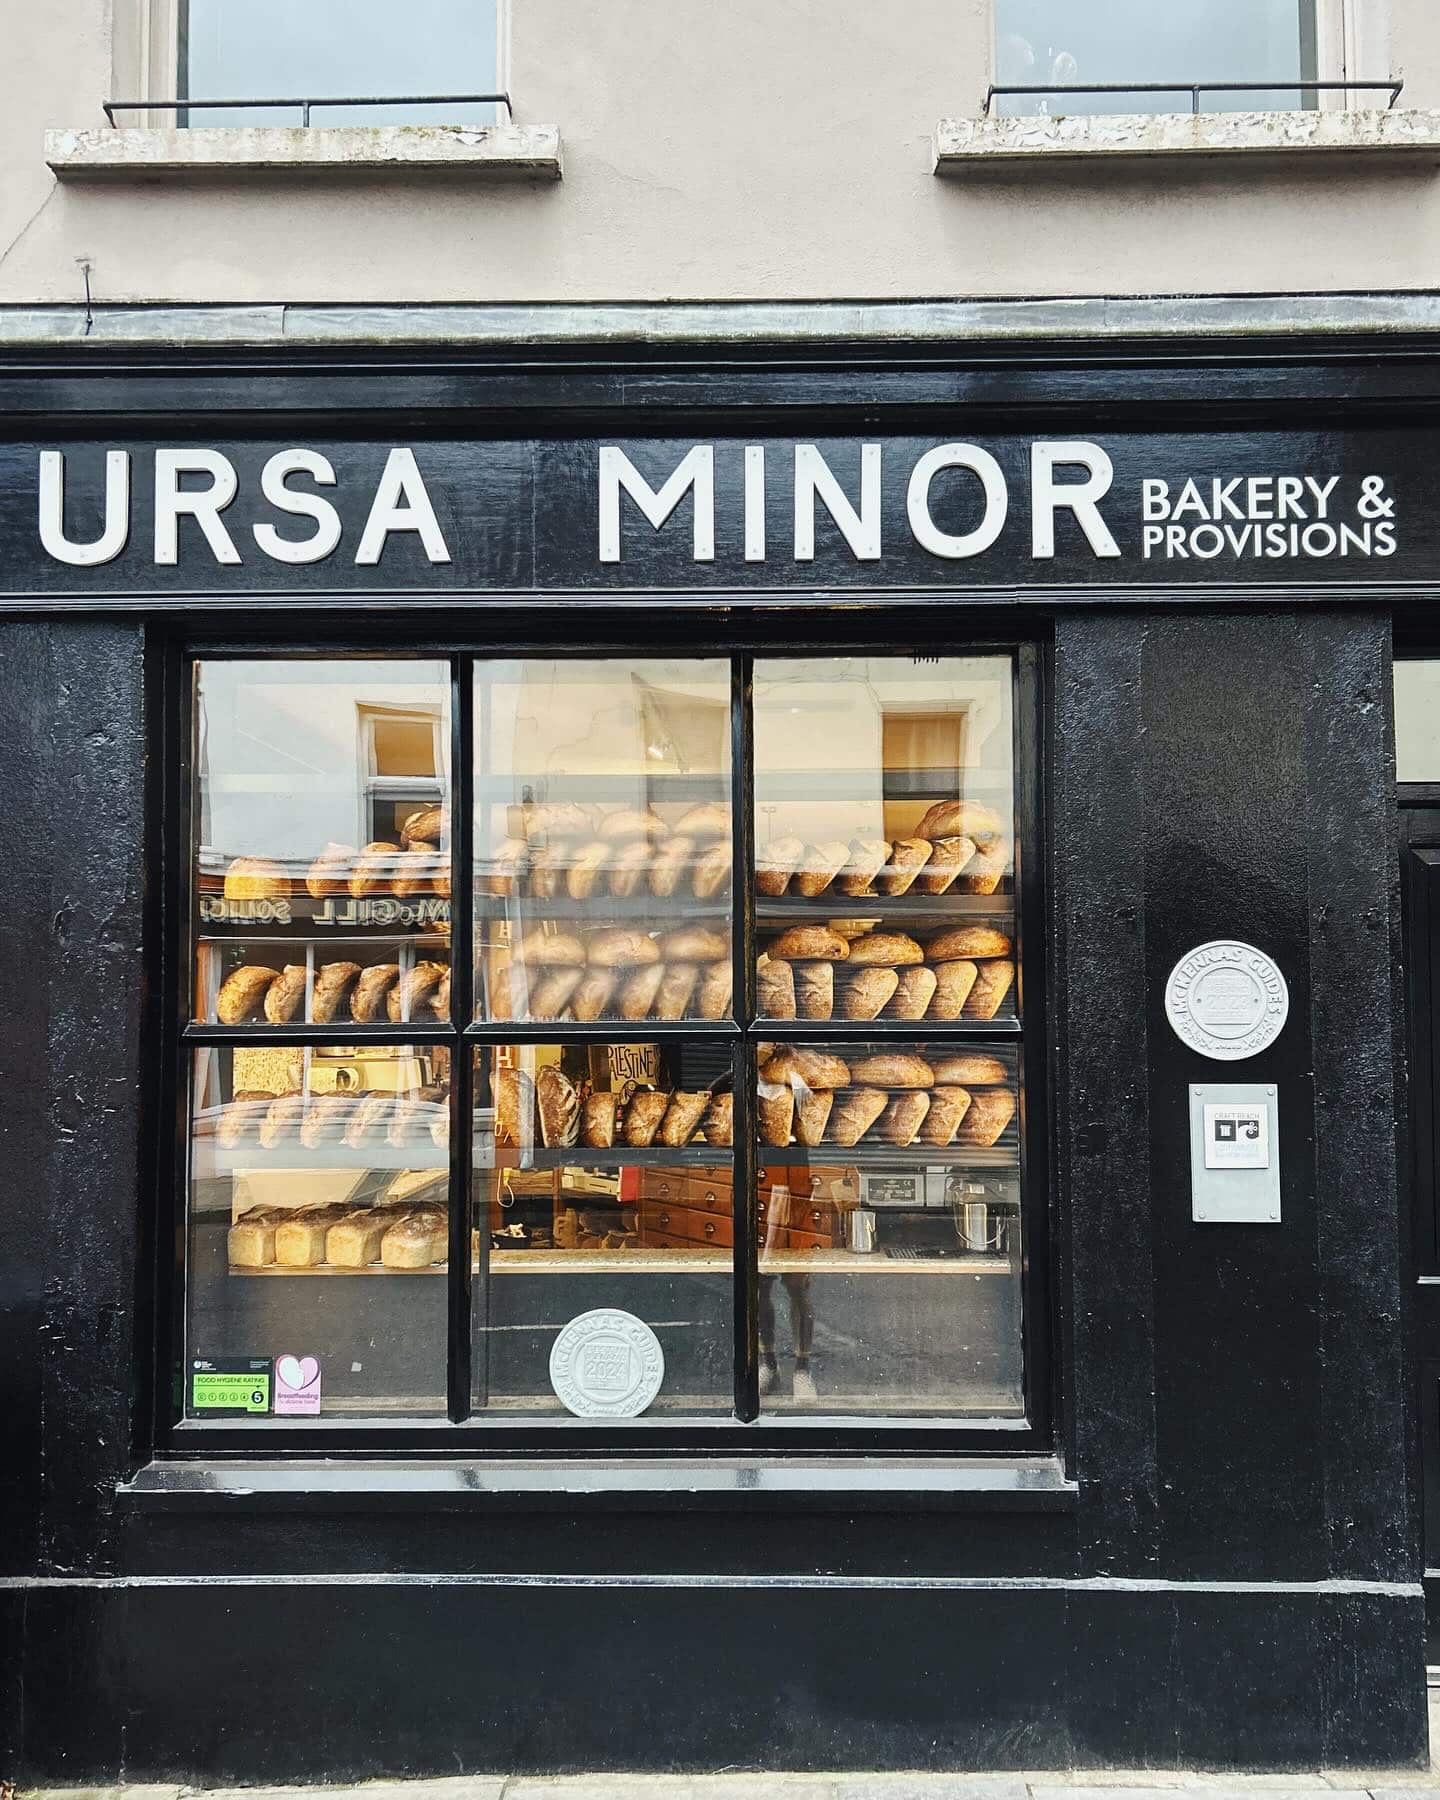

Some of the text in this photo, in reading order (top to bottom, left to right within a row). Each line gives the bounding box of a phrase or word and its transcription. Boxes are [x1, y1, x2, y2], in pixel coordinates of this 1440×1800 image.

[38, 440, 1121, 566] URSA MINOR
[1141, 475, 1396, 522] BAKERY &
[1142, 520, 1397, 560] PROVISIONS
[253, 1392, 262, 1403] 5
